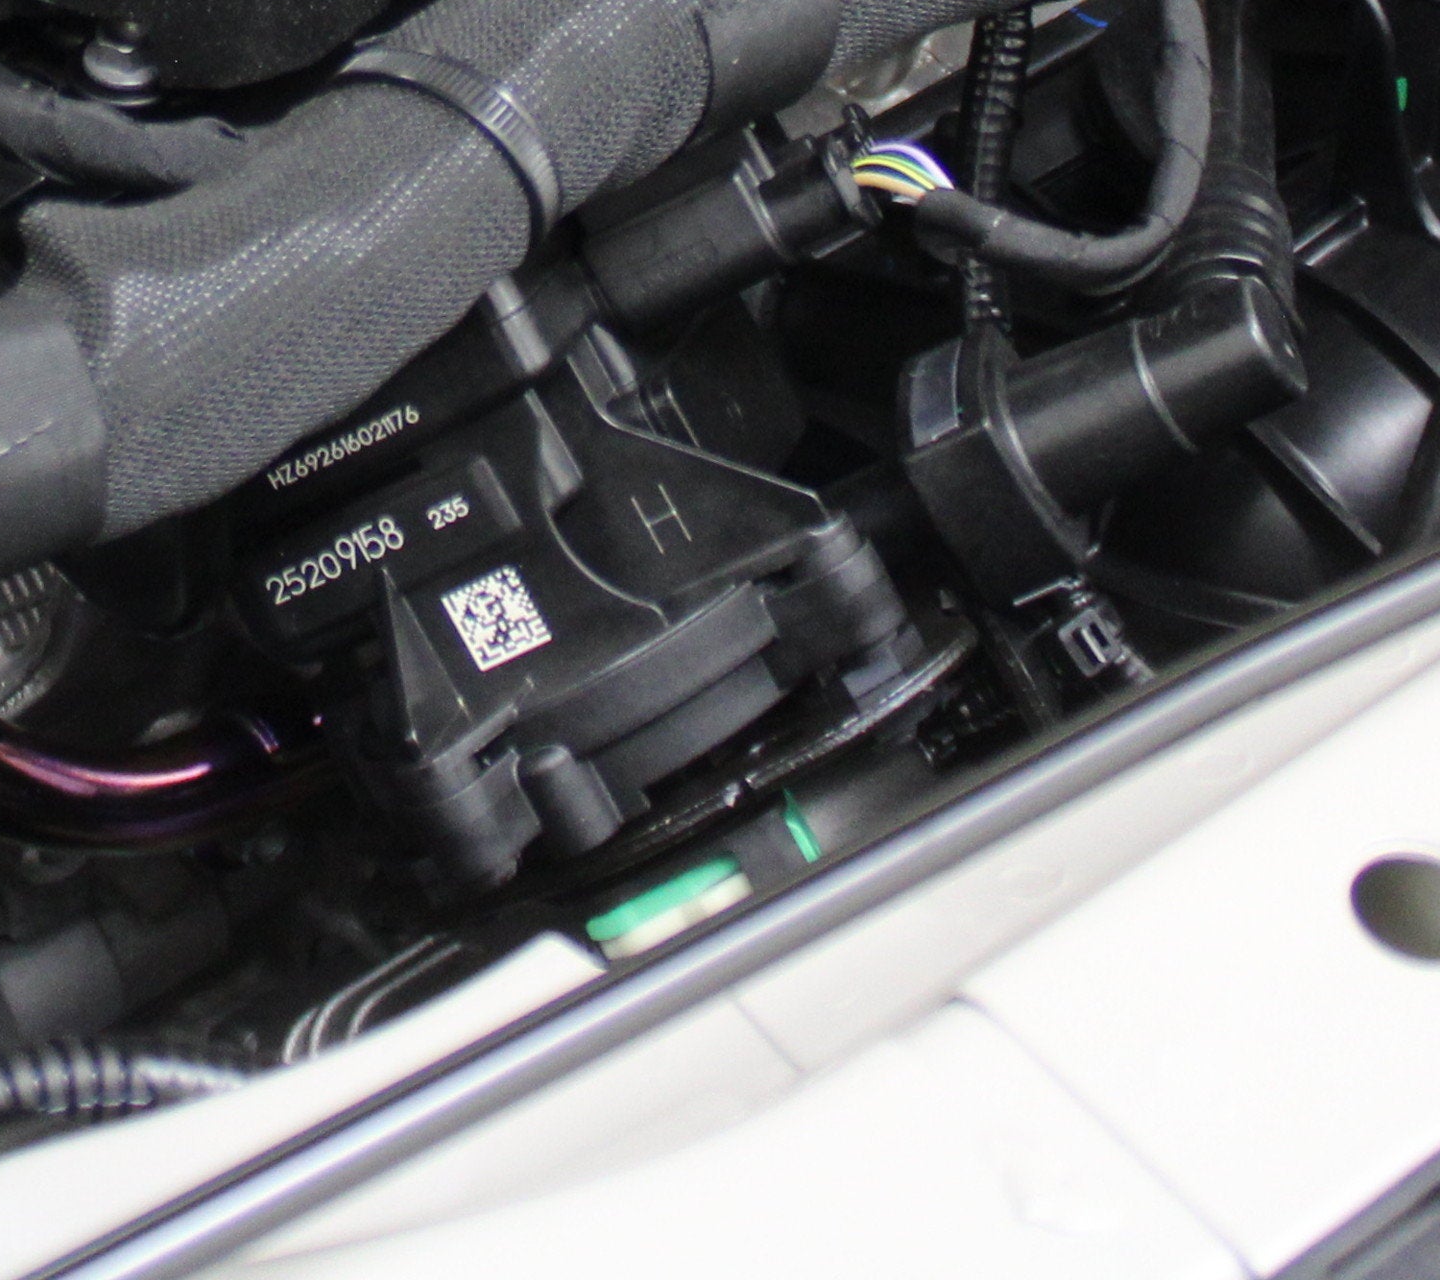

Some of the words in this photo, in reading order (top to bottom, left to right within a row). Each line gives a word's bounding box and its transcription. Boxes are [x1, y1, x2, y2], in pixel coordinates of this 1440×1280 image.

[268, 406, 420, 490] HZ692616021176
[265, 517, 405, 605] 25209158
[428, 495, 469, 531] 235
